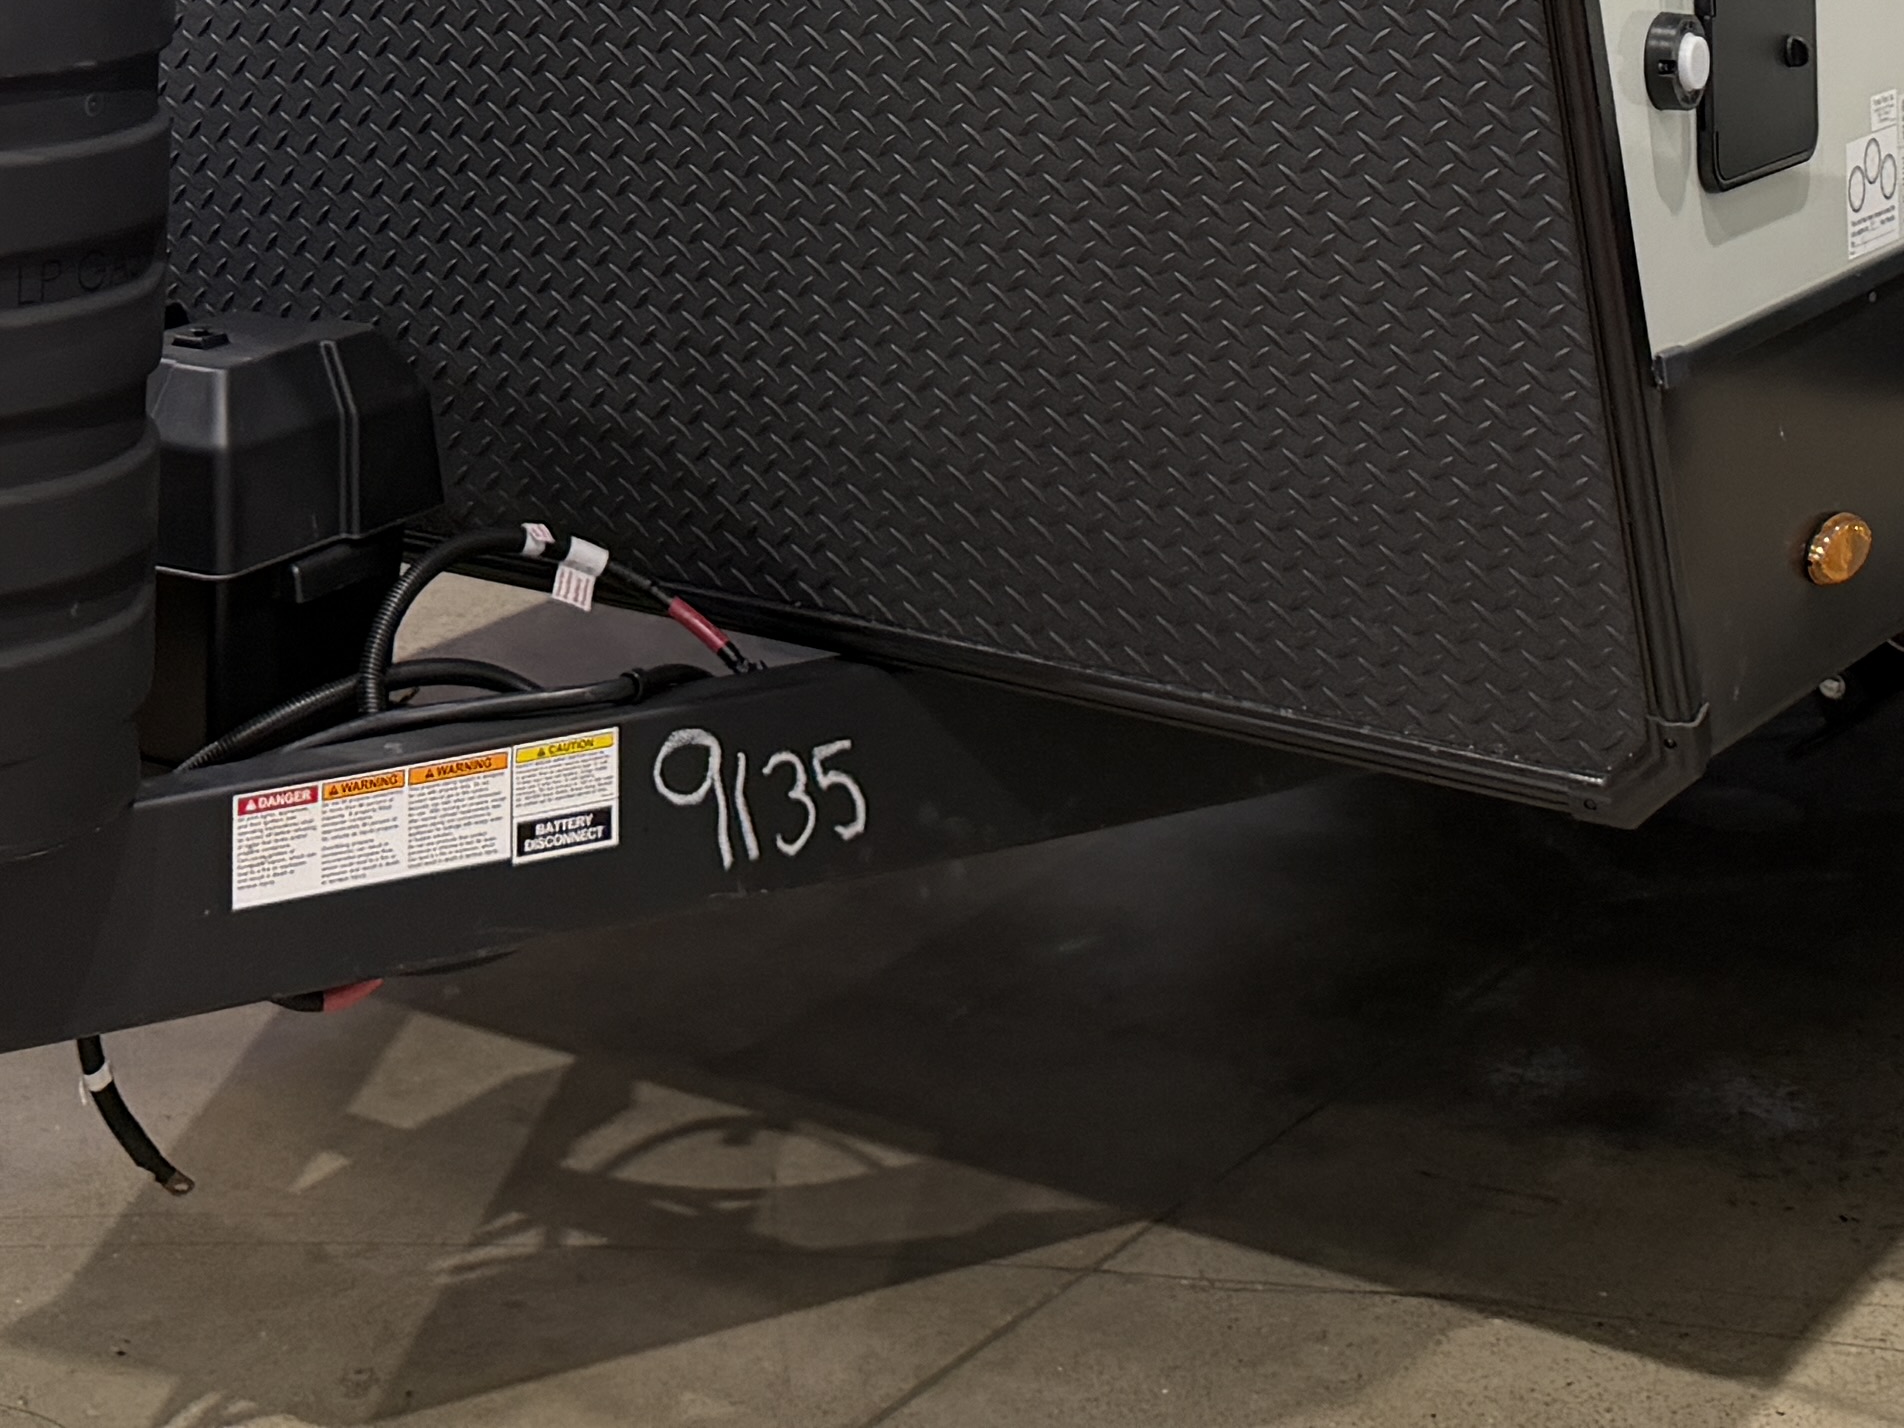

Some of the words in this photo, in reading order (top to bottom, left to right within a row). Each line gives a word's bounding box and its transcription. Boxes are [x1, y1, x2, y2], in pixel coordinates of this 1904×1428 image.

[17, 258, 63, 306] LP
[548, 738, 594, 752] CAUTION
[437, 758, 492, 776] WARNING
[341, 775, 398, 794] WARNING
[258, 789, 311, 808] DANGER
[654, 728, 867, 871] 9135
[535, 813, 594, 831] BATTERY
[524, 826, 605, 852] DISCONNECT
